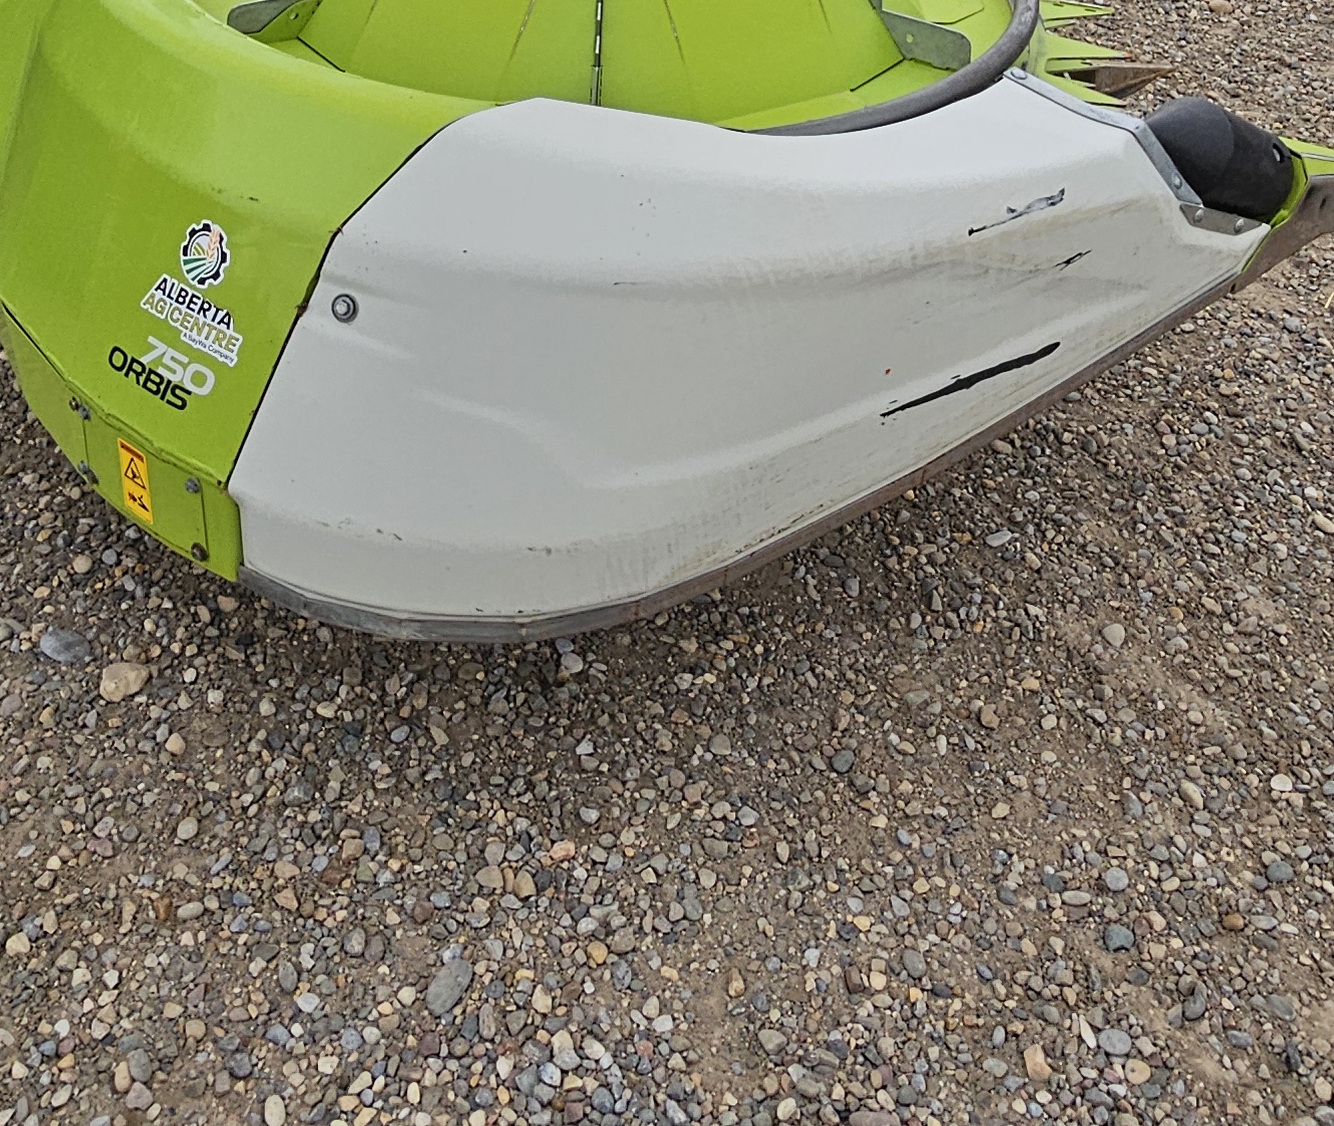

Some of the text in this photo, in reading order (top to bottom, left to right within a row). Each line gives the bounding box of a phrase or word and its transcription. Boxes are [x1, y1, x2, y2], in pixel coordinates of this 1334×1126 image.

[142, 293, 240, 354] AG CENTRE
[154, 277, 233, 330] ALBERTA
[108, 346, 193, 411] ORBIS
[140, 336, 215, 396] 750
[208, 344, 234, 364] Company
